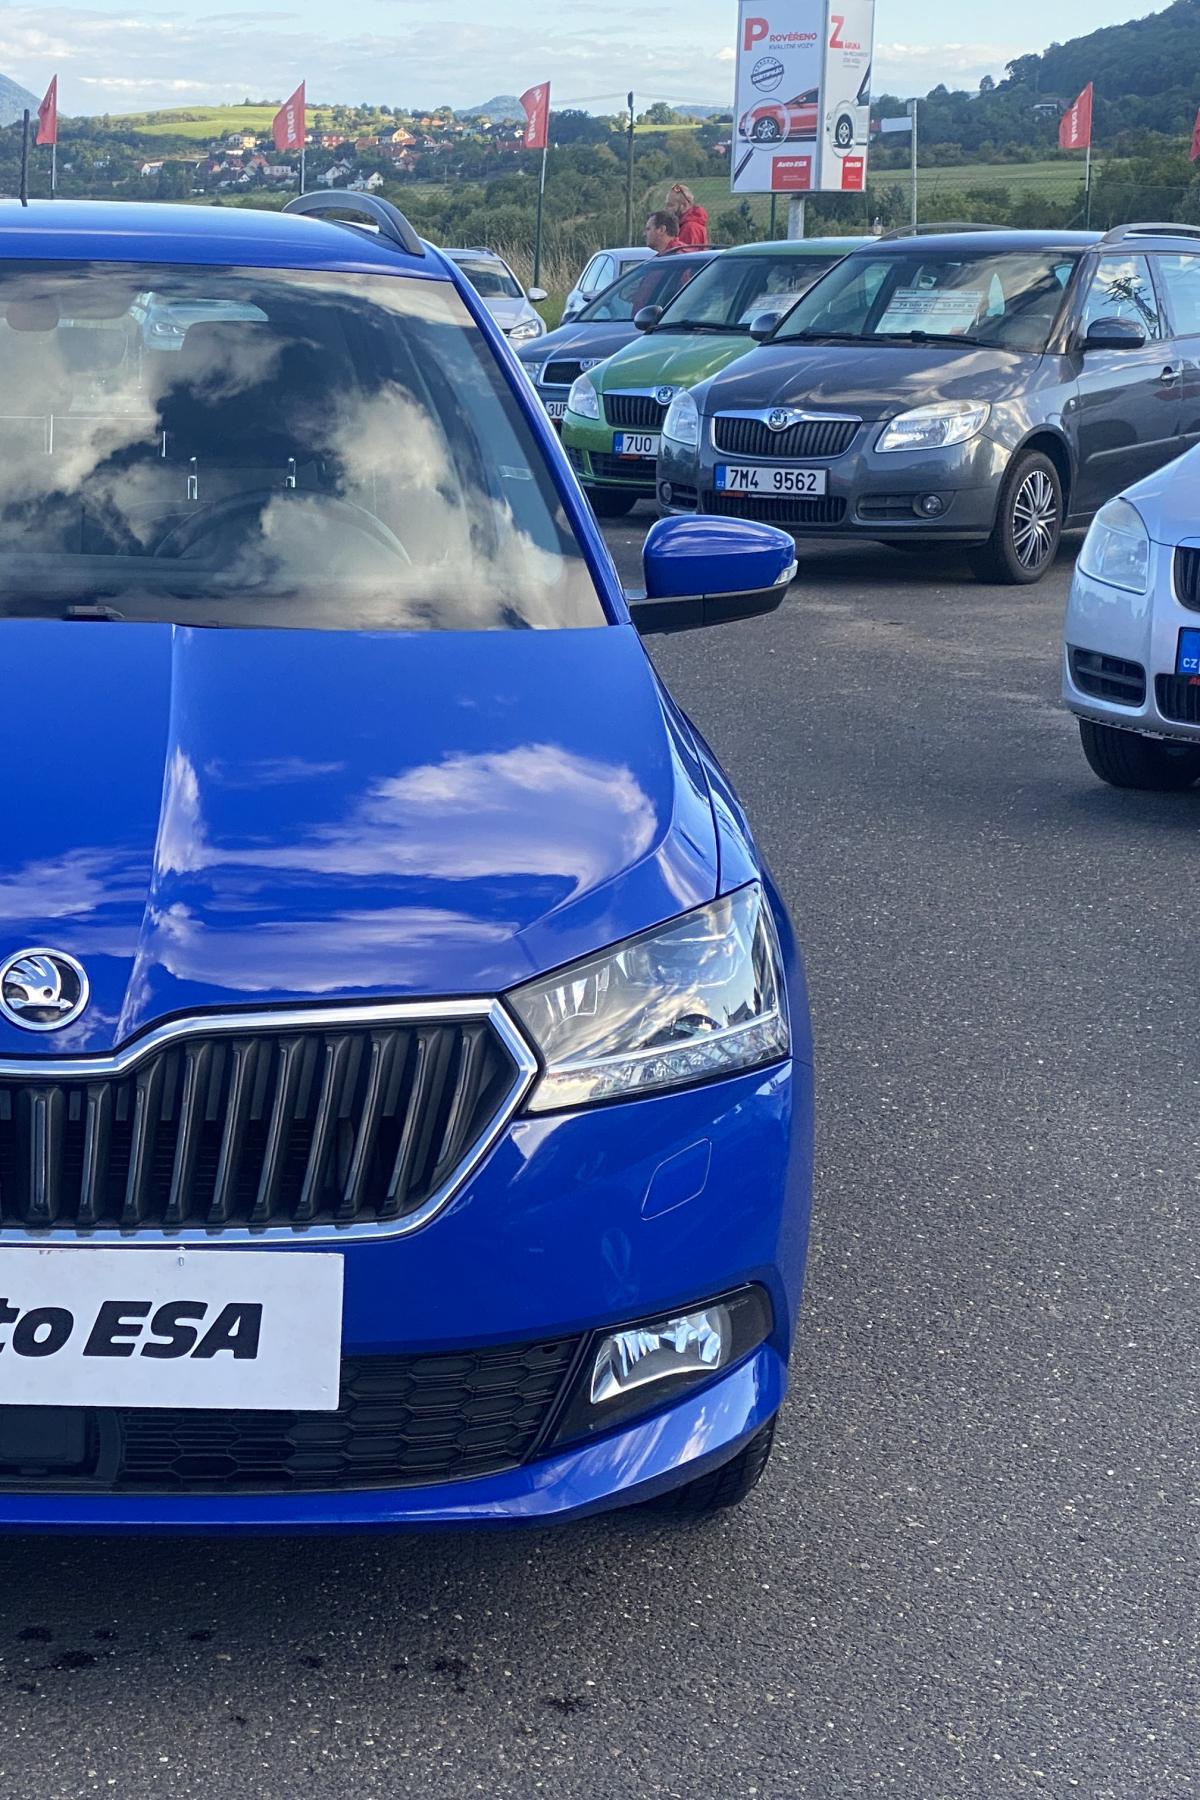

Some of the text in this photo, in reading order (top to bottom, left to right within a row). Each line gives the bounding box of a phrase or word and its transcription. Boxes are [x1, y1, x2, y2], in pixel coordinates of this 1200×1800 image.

[730, 469, 759, 489] 7M4
[773, 471, 817, 491] 9562
[1183, 657, 1198, 668] CZ
[82, 1300, 264, 1360] ESA
